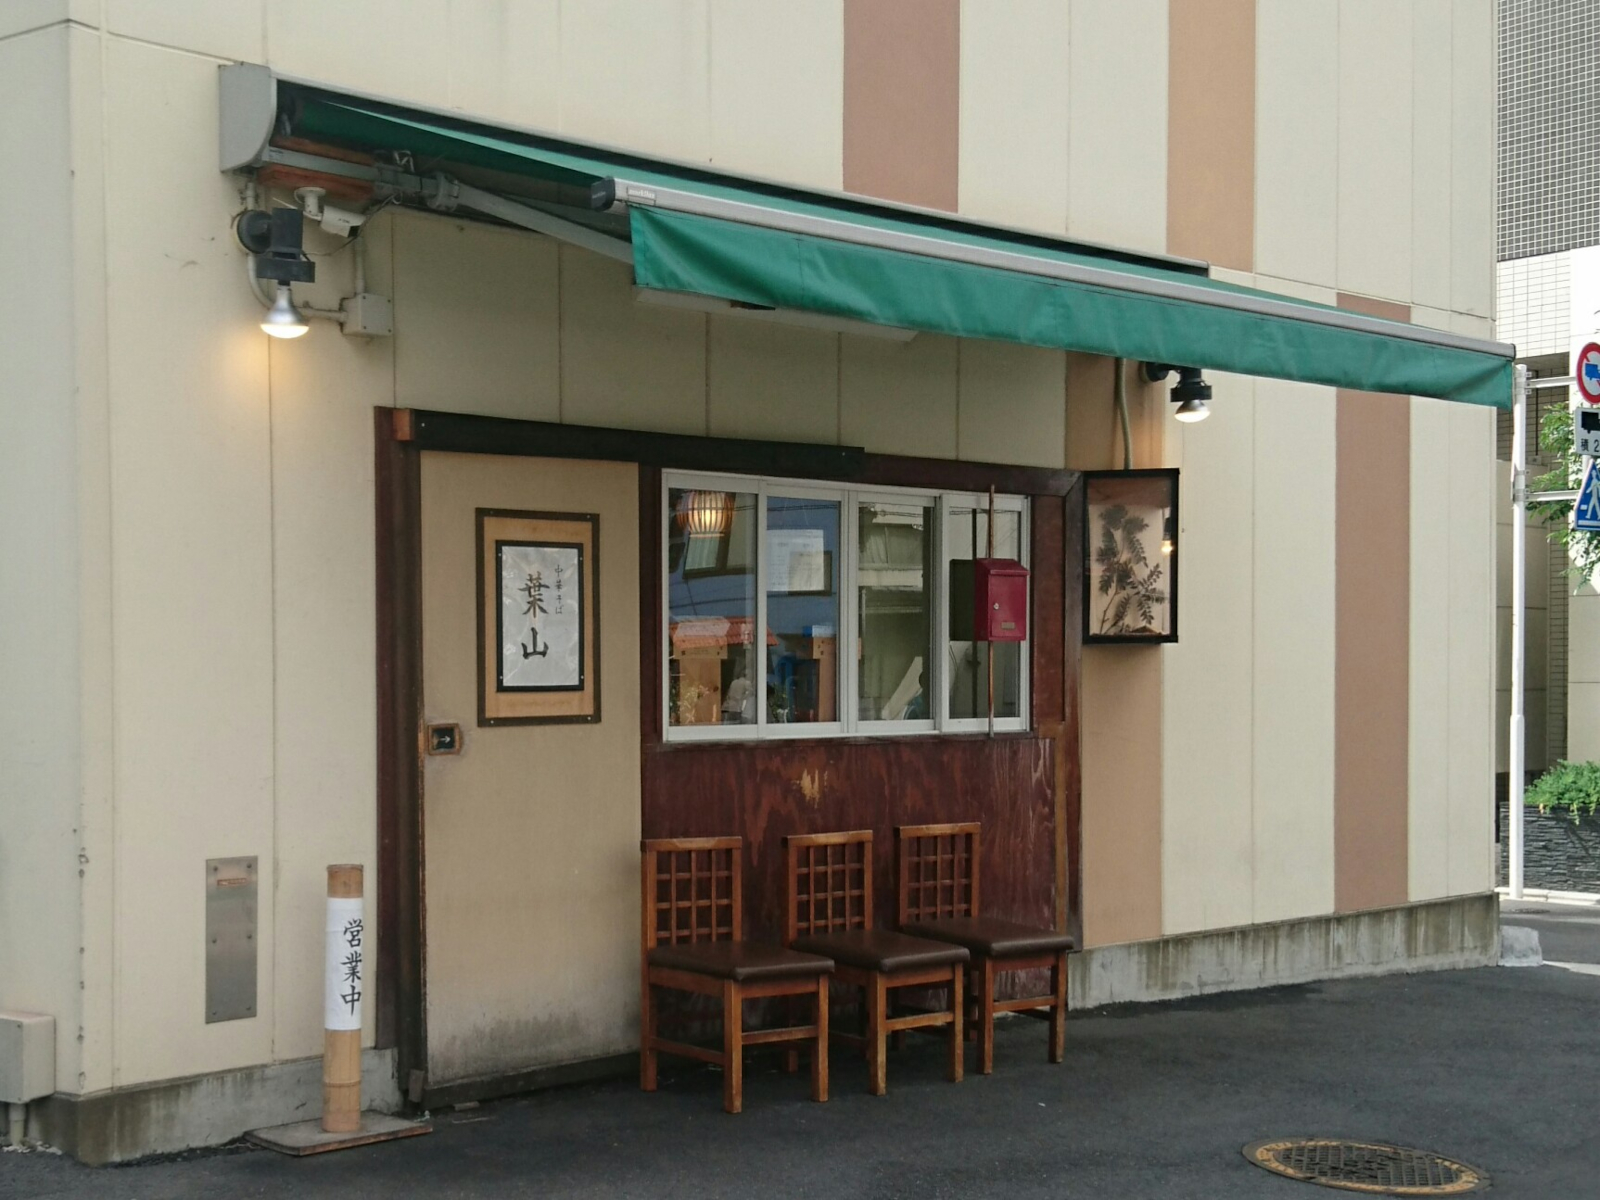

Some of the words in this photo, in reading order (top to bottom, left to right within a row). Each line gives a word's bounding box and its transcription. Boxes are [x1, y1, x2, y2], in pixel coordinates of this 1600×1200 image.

[518, 571, 550, 660] 葉山
[554, 563, 565, 614] 中華そば
[340, 917, 364, 1017] 営業中
